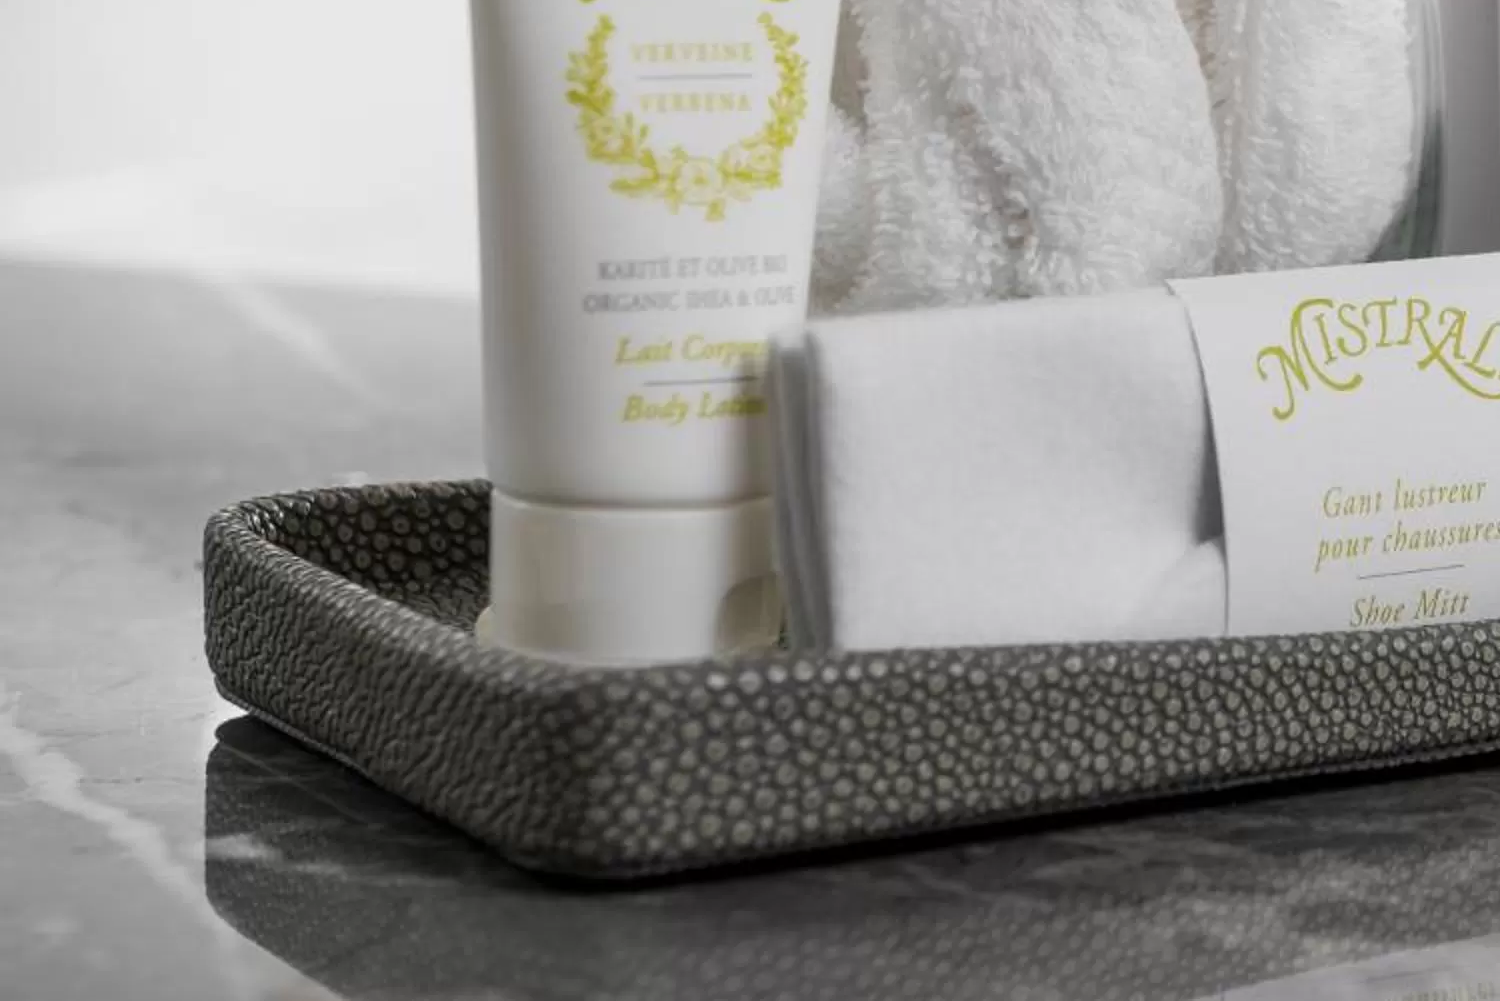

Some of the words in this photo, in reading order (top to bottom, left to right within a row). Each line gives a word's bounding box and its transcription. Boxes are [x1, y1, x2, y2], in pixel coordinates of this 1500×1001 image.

[631, 41, 753, 63] VERVEINE
[639, 91, 752, 113] VERBENA
[676, 256, 702, 279] ET
[705, 254, 759, 276] OLIVE
[615, 333, 673, 364] Lait
[621, 392, 689, 427] Body
[1322, 485, 1382, 519] Gant
[1393, 477, 1487, 512] lustreur
[1313, 533, 1374, 574] pour
[1350, 595, 1406, 627] Shoe
[1414, 587, 1470, 621] Mitt
